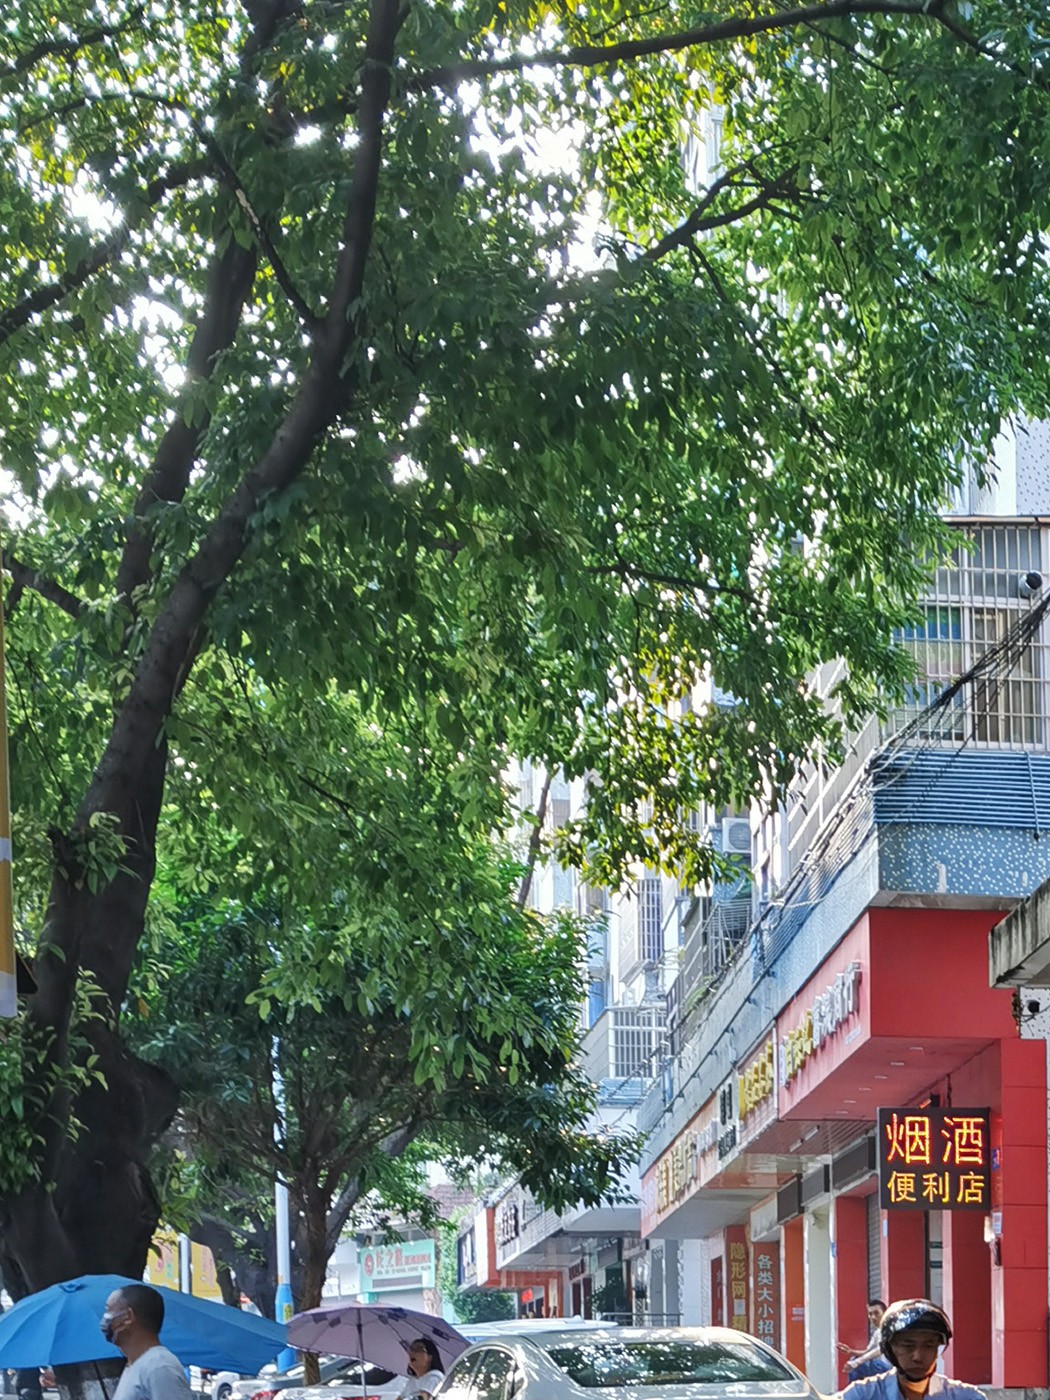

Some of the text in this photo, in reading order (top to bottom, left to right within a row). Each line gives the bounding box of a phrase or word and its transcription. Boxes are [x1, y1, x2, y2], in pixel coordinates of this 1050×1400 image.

[886, 1113, 985, 1164] 烟酒
[887, 1171, 985, 1203] 便利店
[730, 1242, 748, 1332] 隐形网
